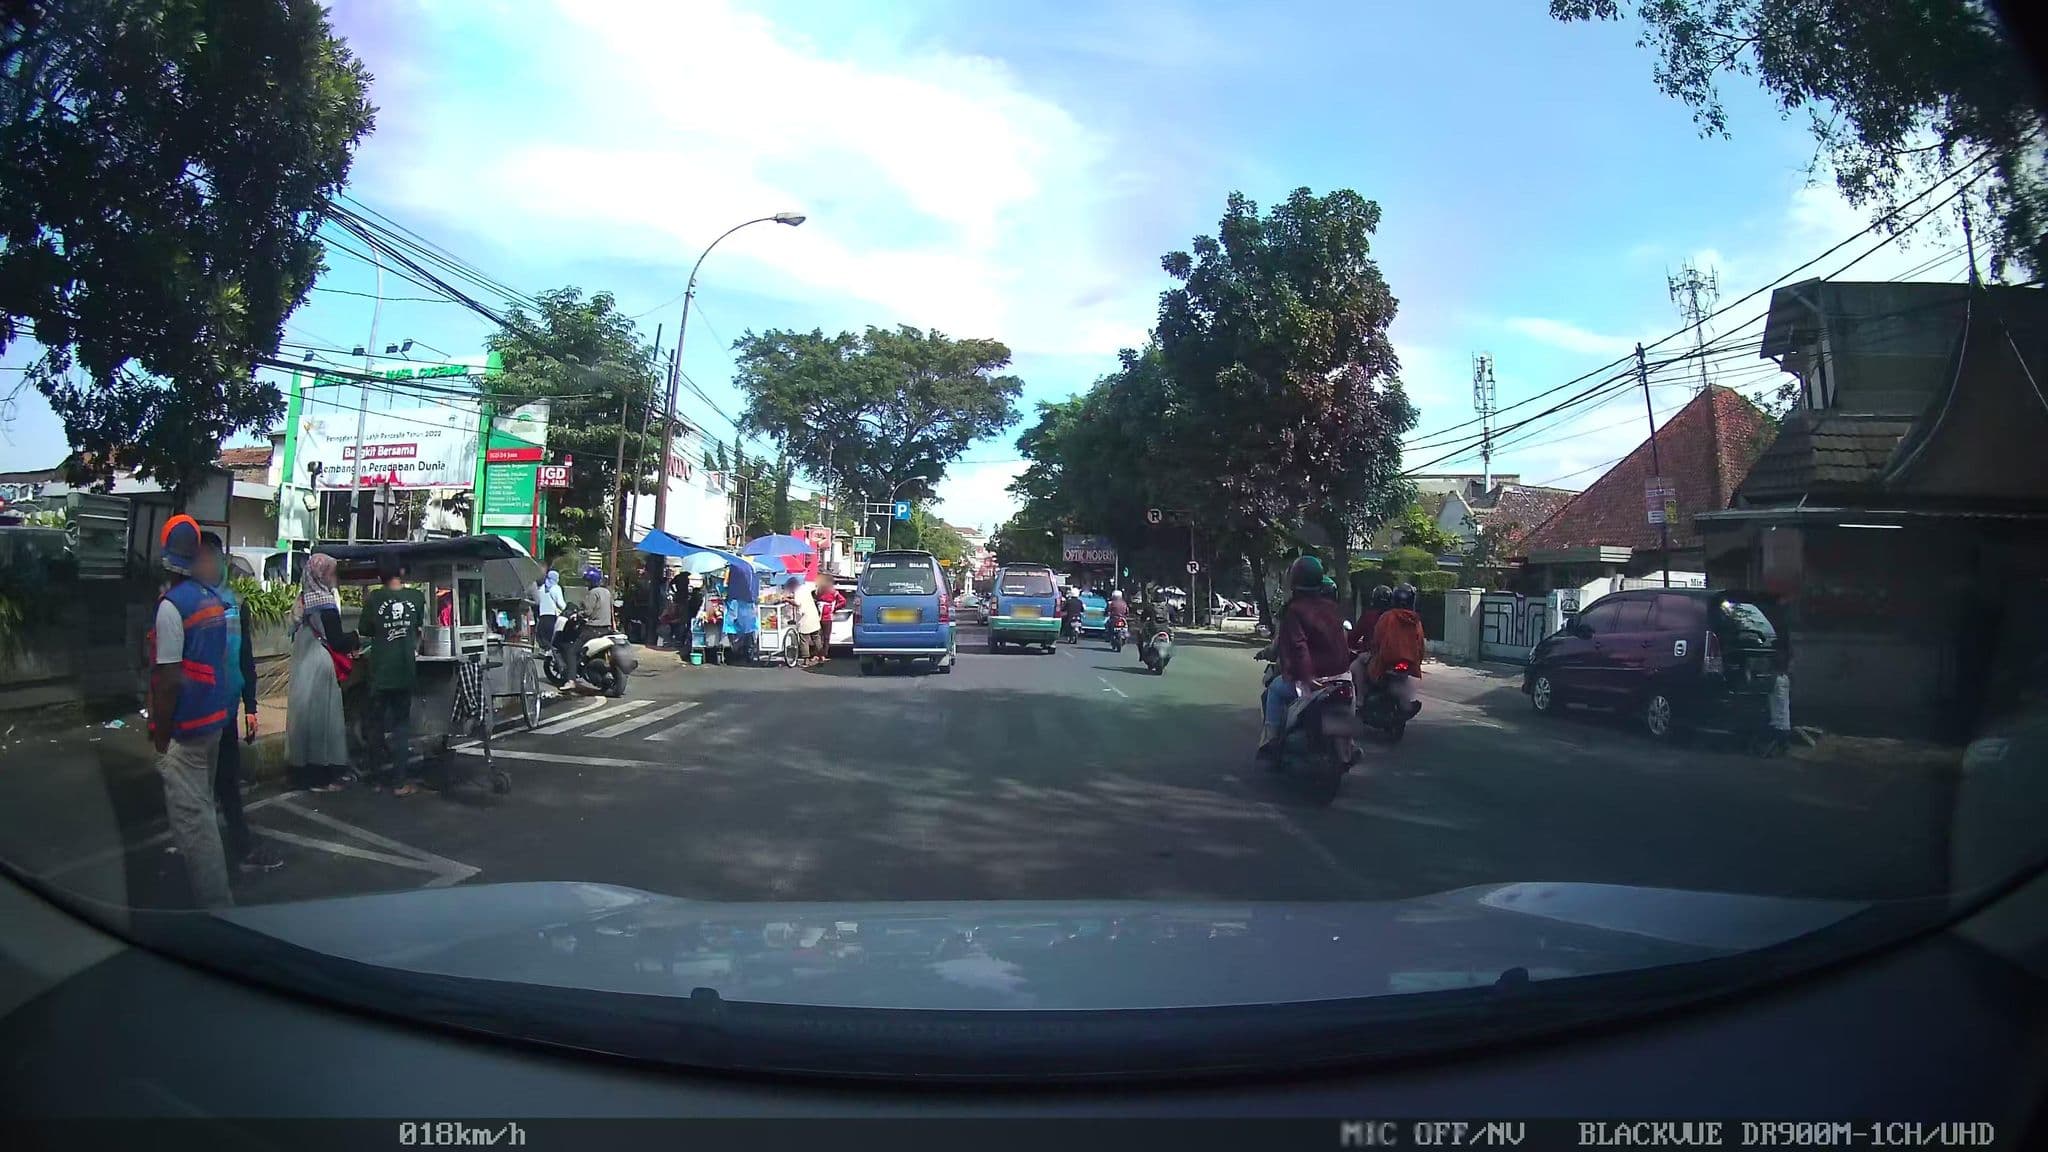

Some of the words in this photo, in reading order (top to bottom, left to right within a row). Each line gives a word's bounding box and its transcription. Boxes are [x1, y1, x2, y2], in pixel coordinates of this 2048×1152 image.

[344, 446, 376, 459] Bagkit
[377, 445, 415, 457] Bersama
[369, 461, 414, 473] Peradaban
[417, 460, 446, 471] Dunia
[540, 467, 566, 480] IGD
[897, 504, 907, 517] P
